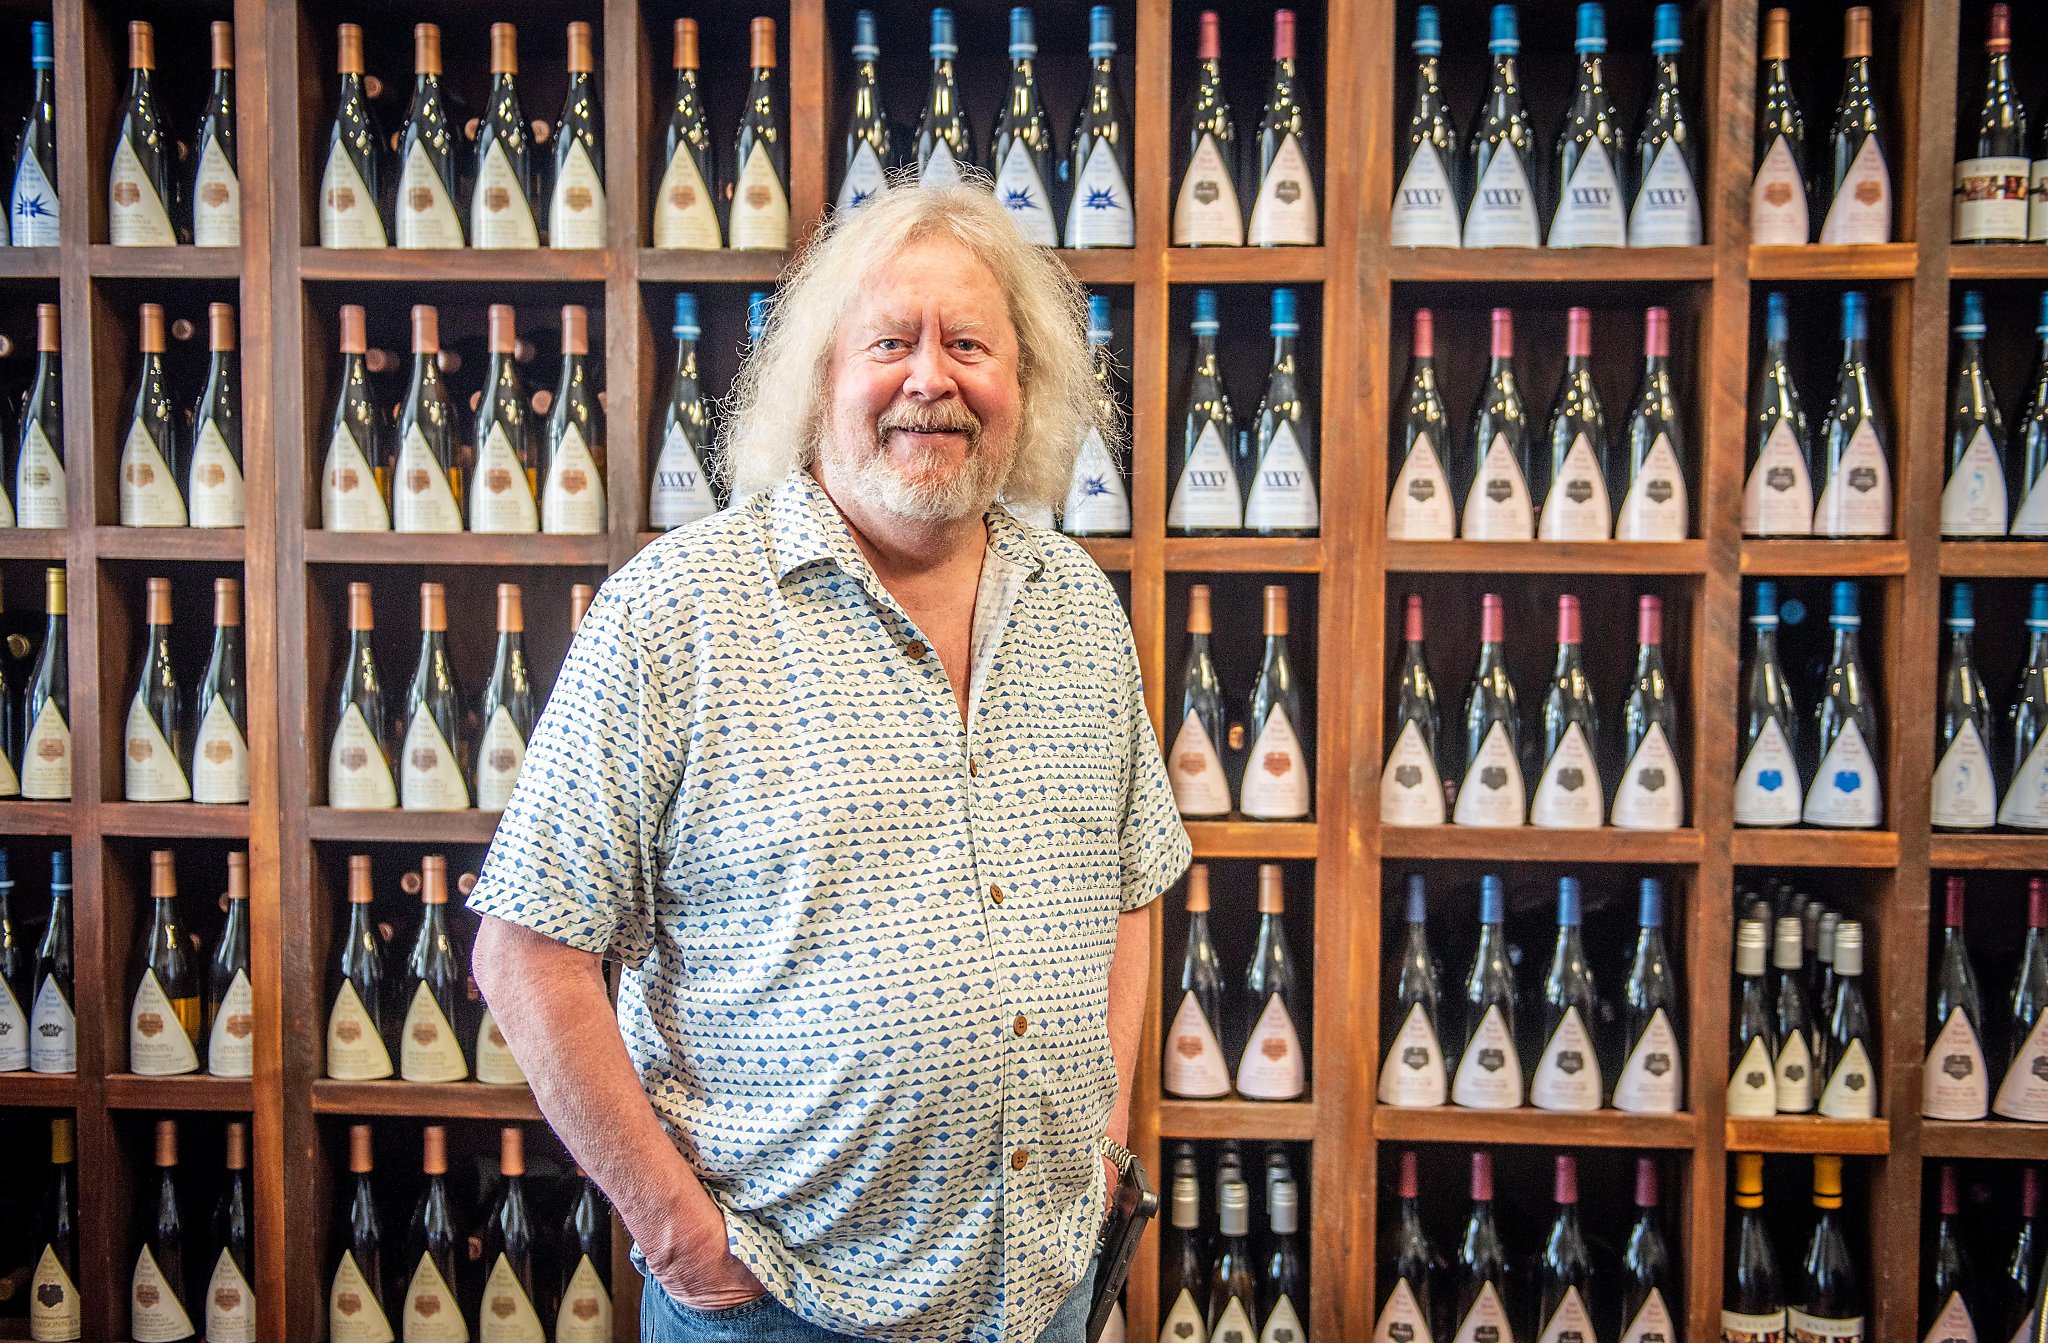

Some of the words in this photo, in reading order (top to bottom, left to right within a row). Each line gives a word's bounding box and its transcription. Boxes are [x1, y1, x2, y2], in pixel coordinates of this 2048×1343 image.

[1403, 188, 1444, 205] XXXV
[1483, 188, 1524, 205] XXXV
[1572, 187, 1613, 204] XXXV
[1647, 188, 1689, 205] XXXV
[659, 471, 697, 487] XXXV
[1188, 470, 1228, 486] XXXV
[1263, 470, 1303, 486] XXXV
